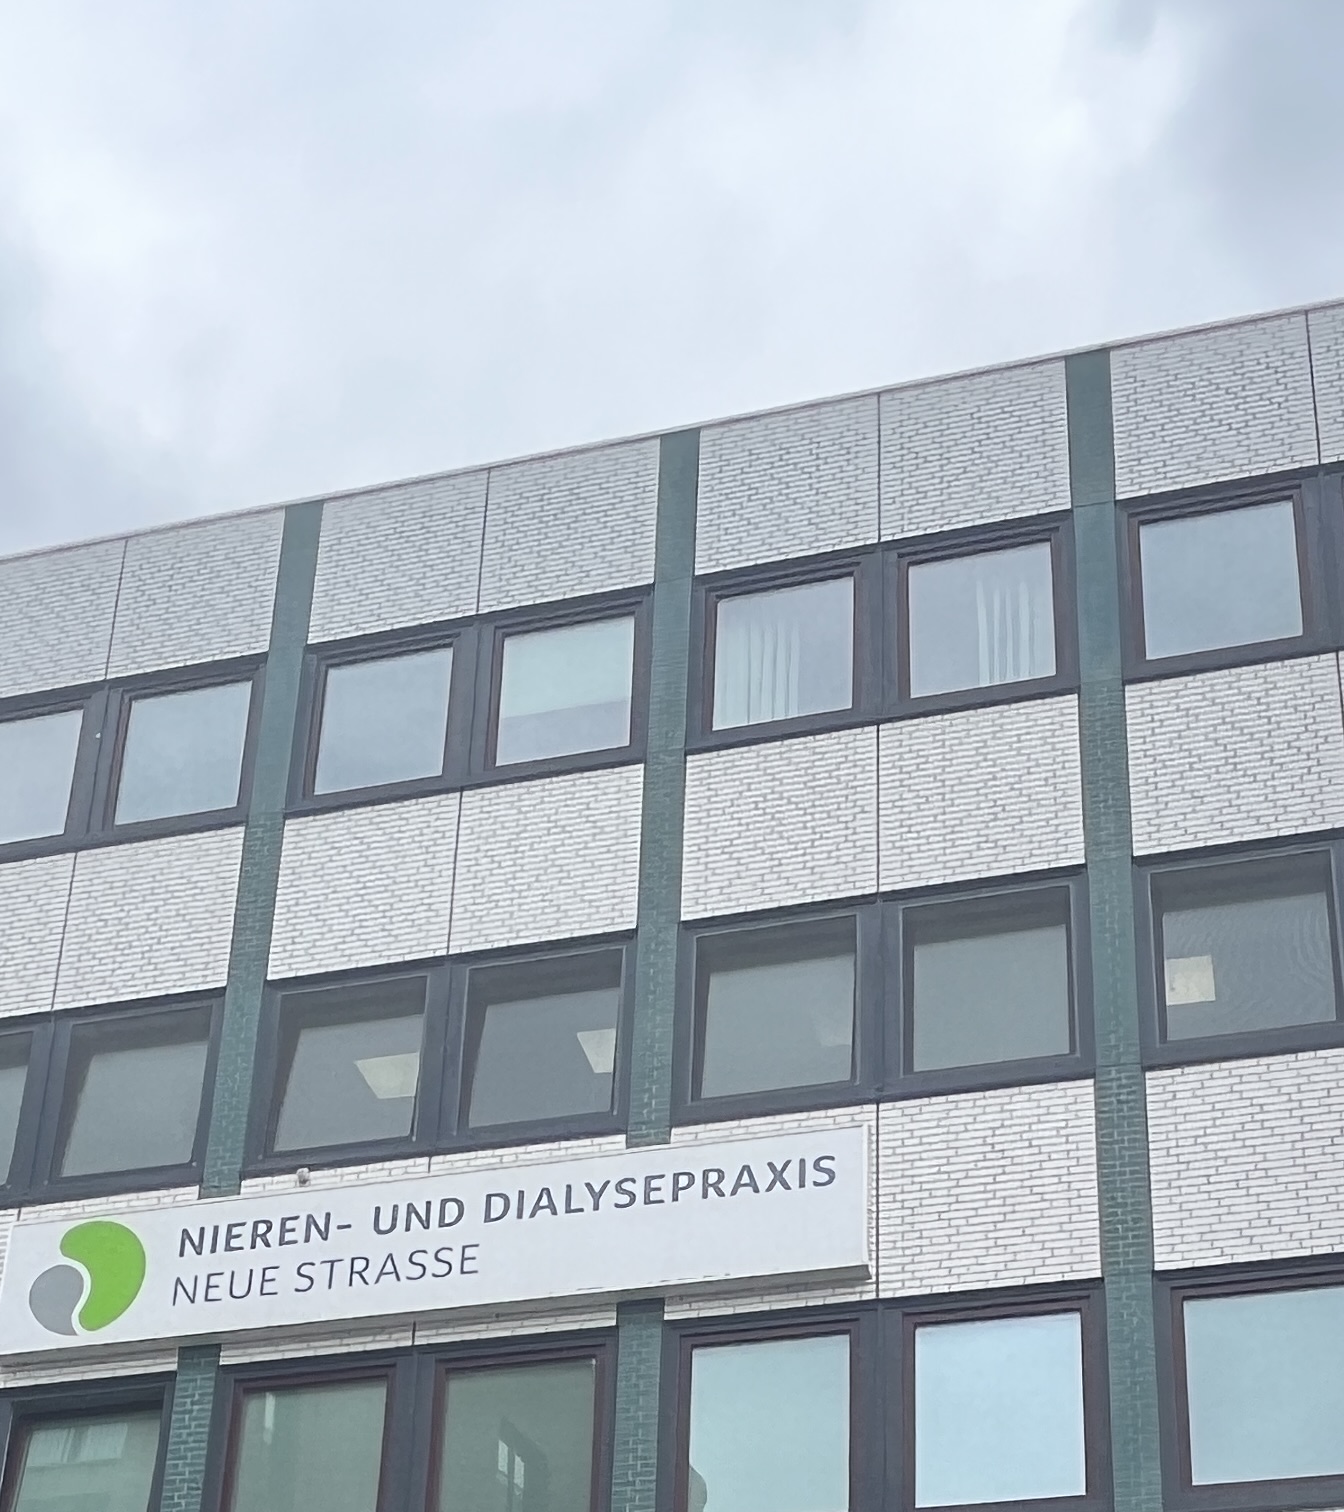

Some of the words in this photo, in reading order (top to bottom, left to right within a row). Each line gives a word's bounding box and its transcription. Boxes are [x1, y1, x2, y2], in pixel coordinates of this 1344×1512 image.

[178, 1211, 352, 1258] NIEREN-
[372, 1197, 465, 1236] UND
[482, 1154, 837, 1224] DIALYSEPRAXIS
[171, 1265, 281, 1307] NEUE
[293, 1243, 481, 1294] STRASSE
